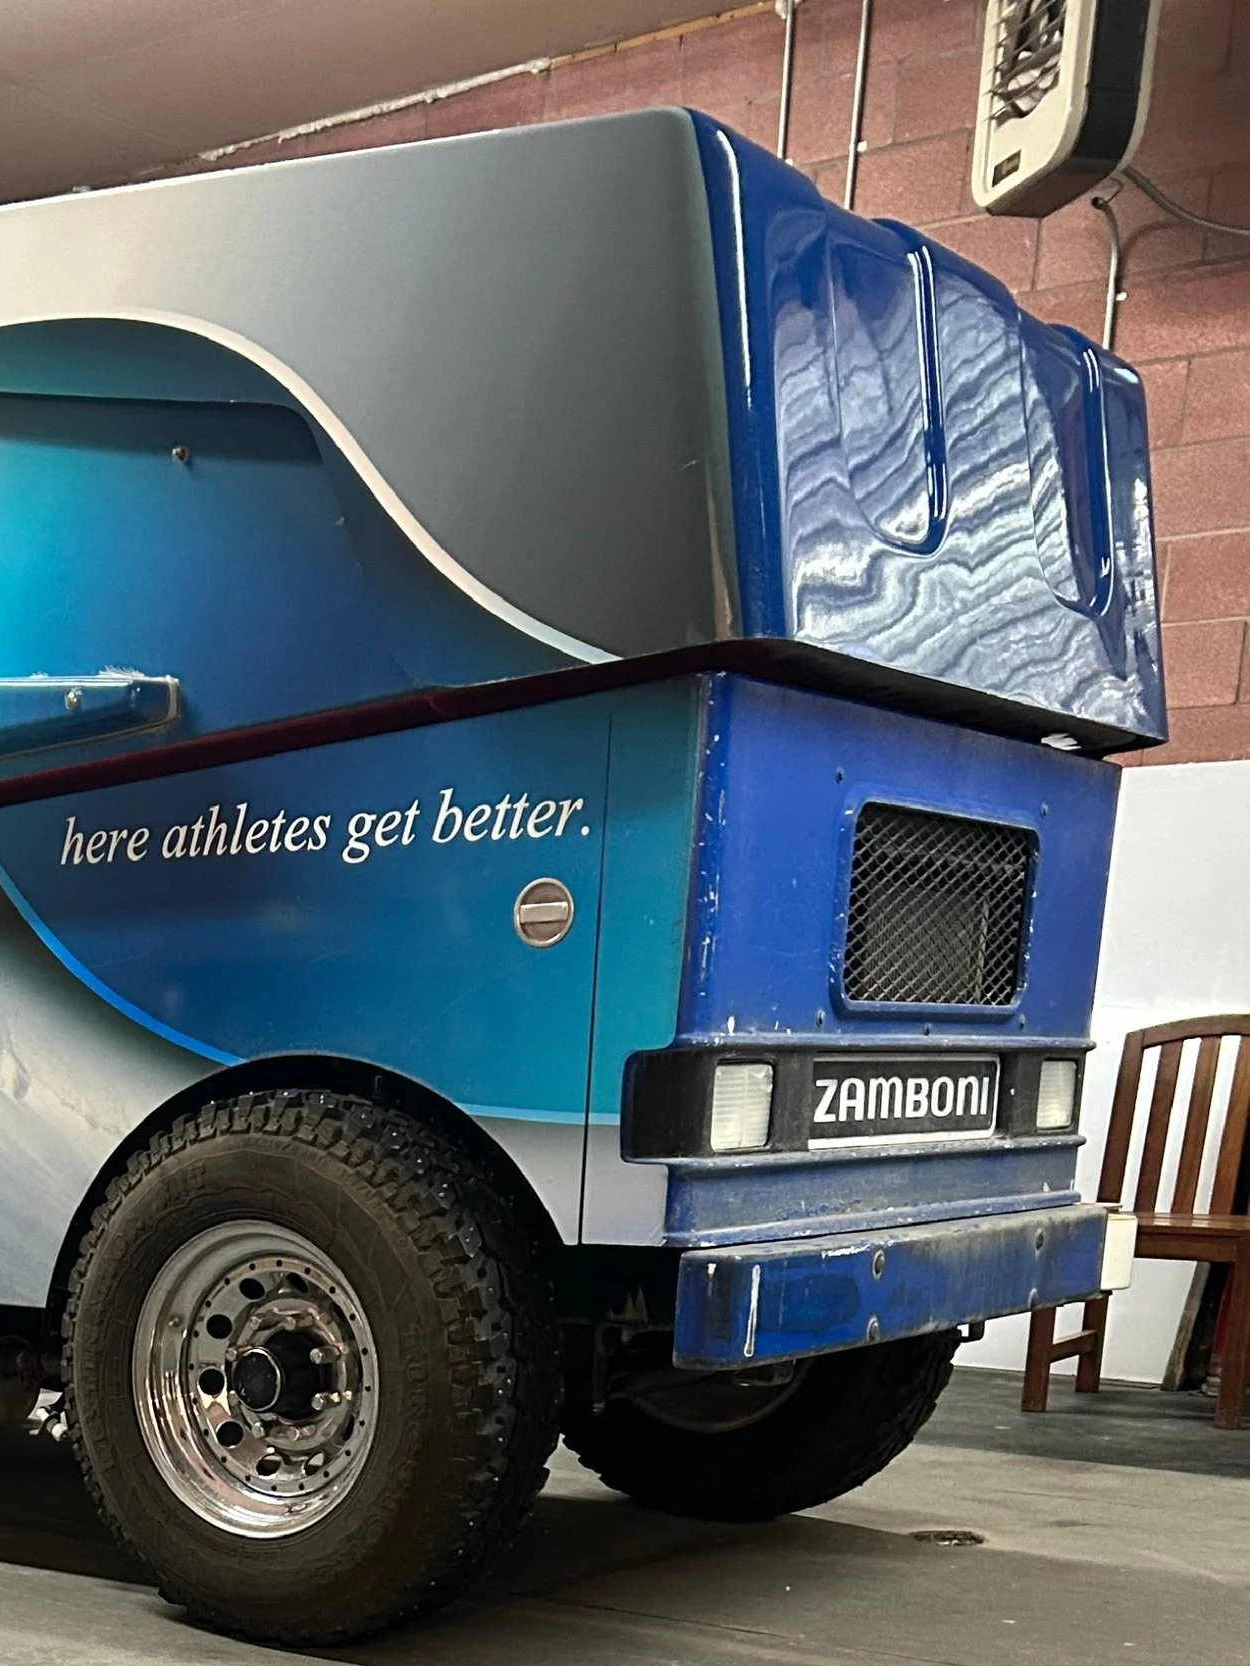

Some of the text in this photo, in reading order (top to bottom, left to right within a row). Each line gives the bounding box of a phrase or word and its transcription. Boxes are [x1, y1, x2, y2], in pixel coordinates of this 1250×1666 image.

[60, 787, 591, 866] here athletes get better.
[813, 1076, 990, 1123] ZAMBONI
